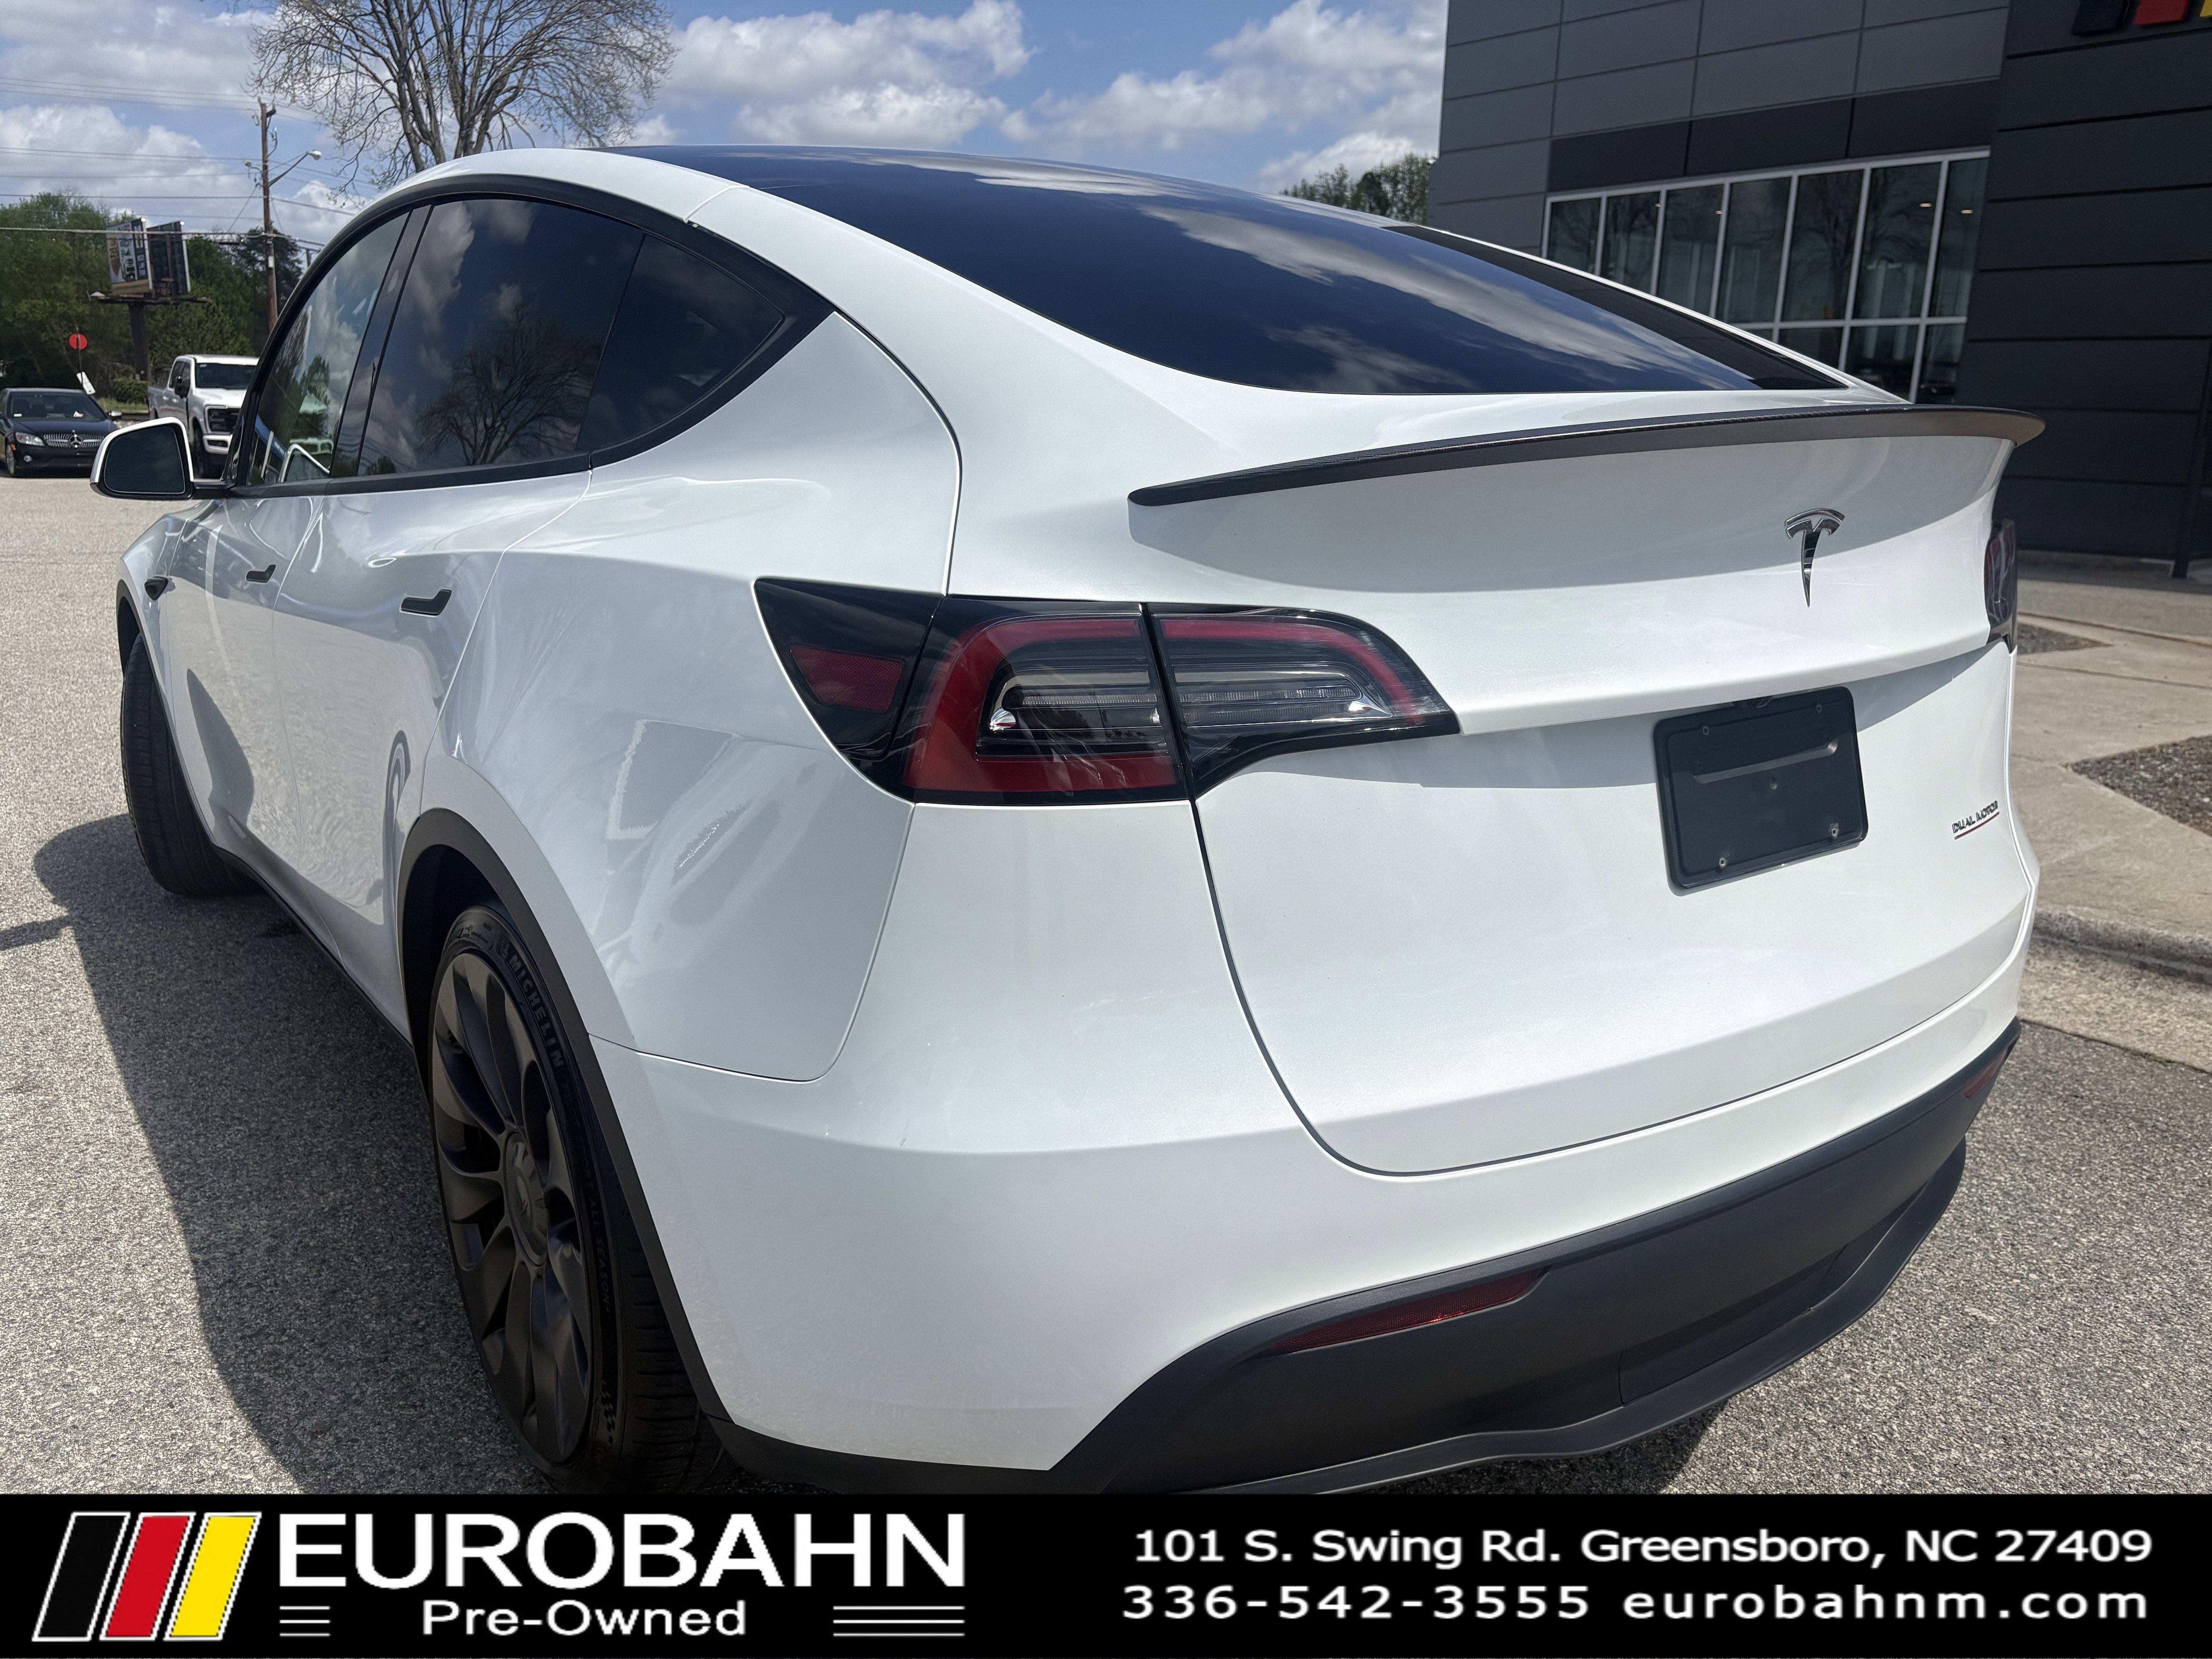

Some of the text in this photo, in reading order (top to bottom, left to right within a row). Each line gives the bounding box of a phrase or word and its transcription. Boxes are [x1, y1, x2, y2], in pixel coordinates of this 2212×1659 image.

[1952, 800, 1998, 833] DUAL MOTOR
[508, 954, 565, 1068] MICHELIN
[596, 1237, 610, 1305] SEASON
